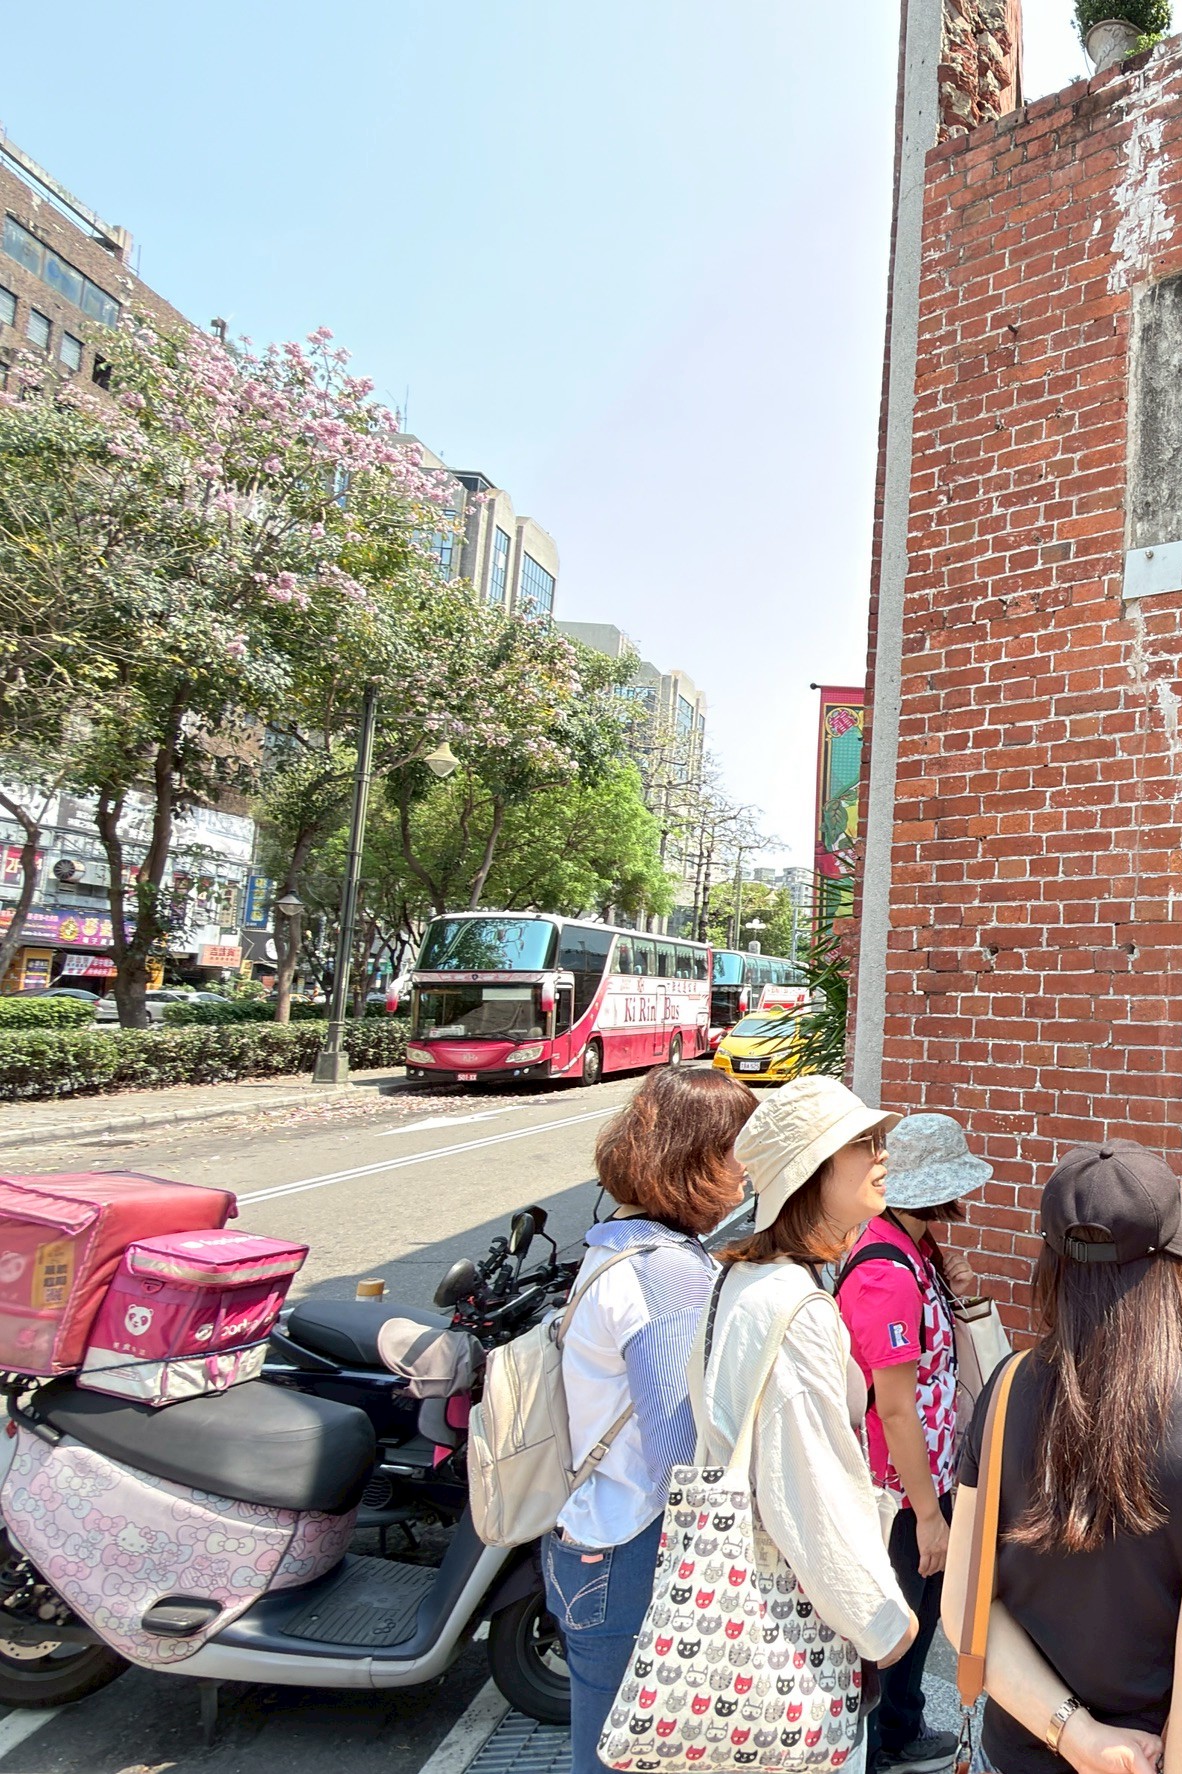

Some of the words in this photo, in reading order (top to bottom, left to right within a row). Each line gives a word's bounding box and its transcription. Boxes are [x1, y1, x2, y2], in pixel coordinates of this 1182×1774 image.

[624, 996, 637, 1023] Ki
[638, 997, 657, 1022] Rin
[664, 996, 680, 1020] Bus
[887, 1321, 910, 1349] R
